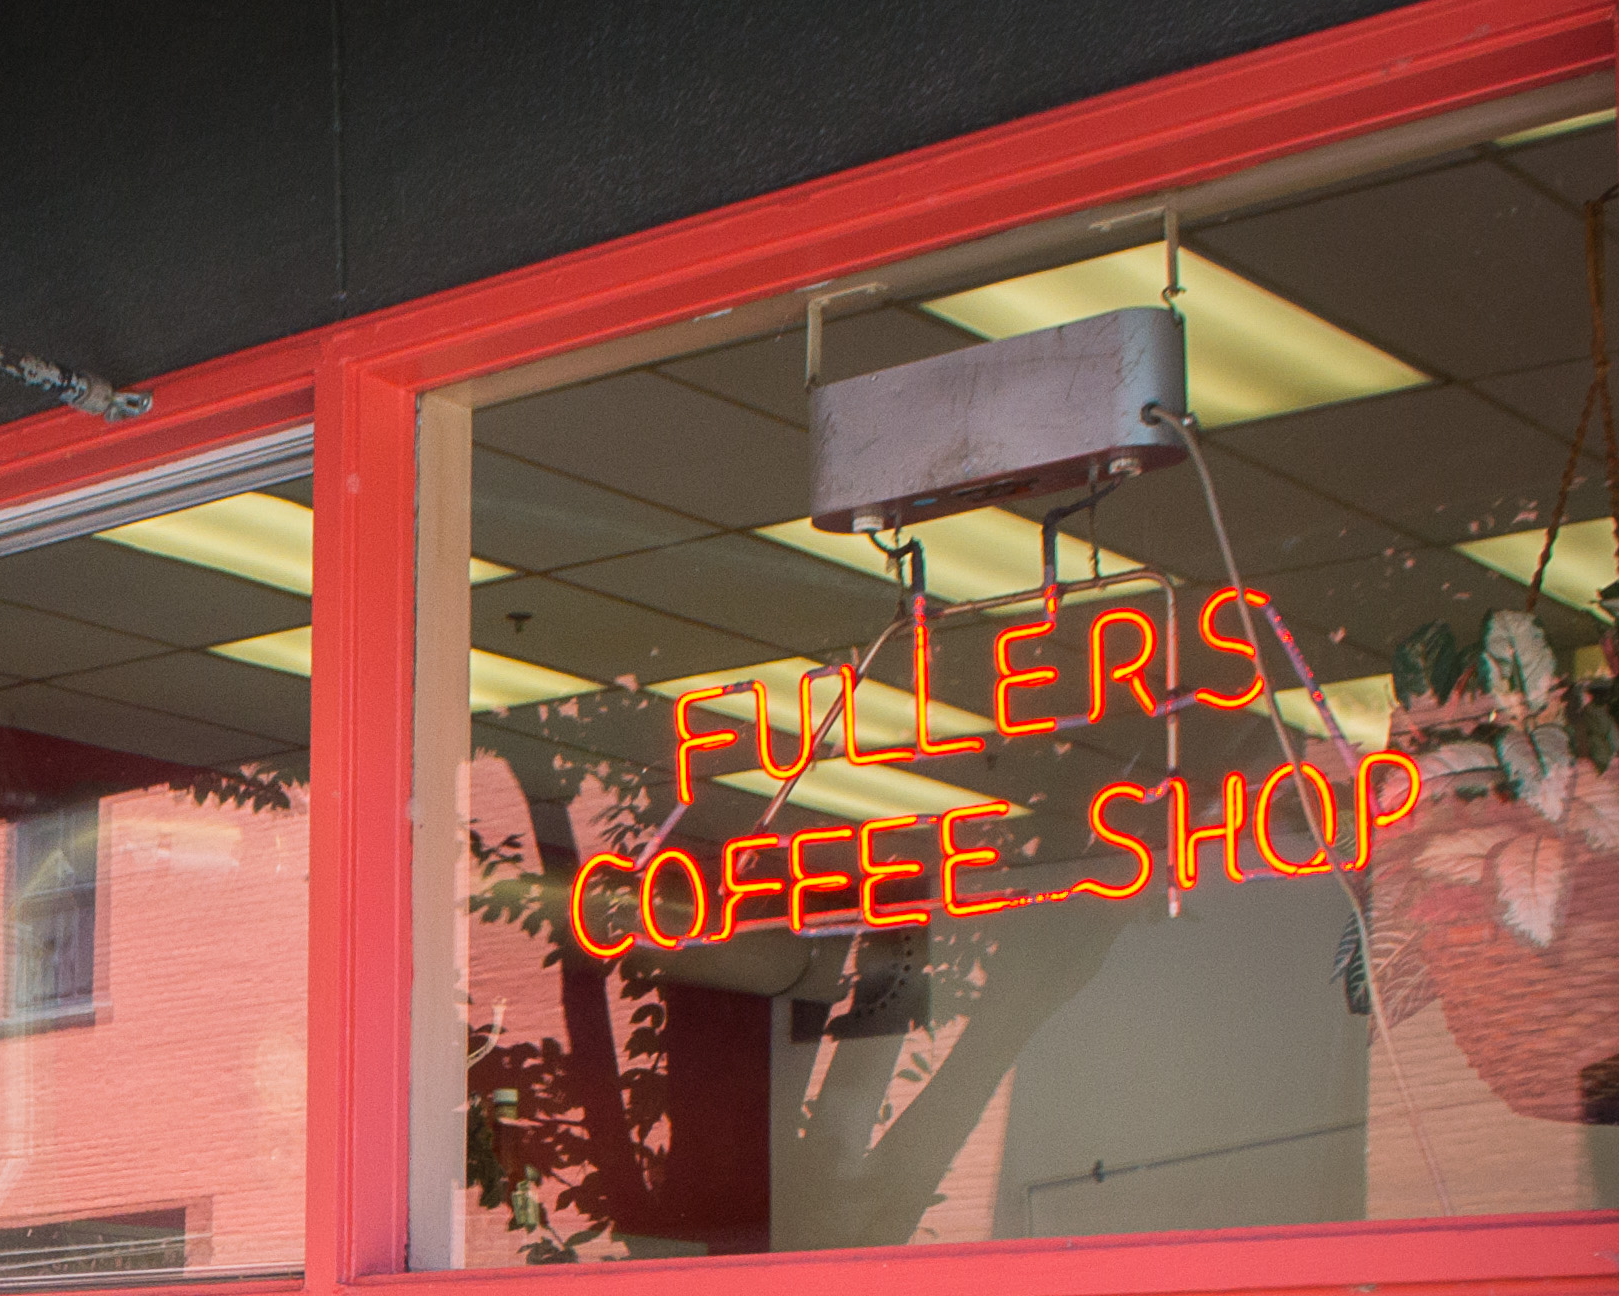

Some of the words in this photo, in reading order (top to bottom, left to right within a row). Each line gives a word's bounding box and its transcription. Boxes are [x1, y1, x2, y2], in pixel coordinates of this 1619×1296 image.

[673, 586, 1270, 804] FULLERS
[571, 800, 1008, 957] COFFEE
[1075, 751, 1421, 898] SHOP
